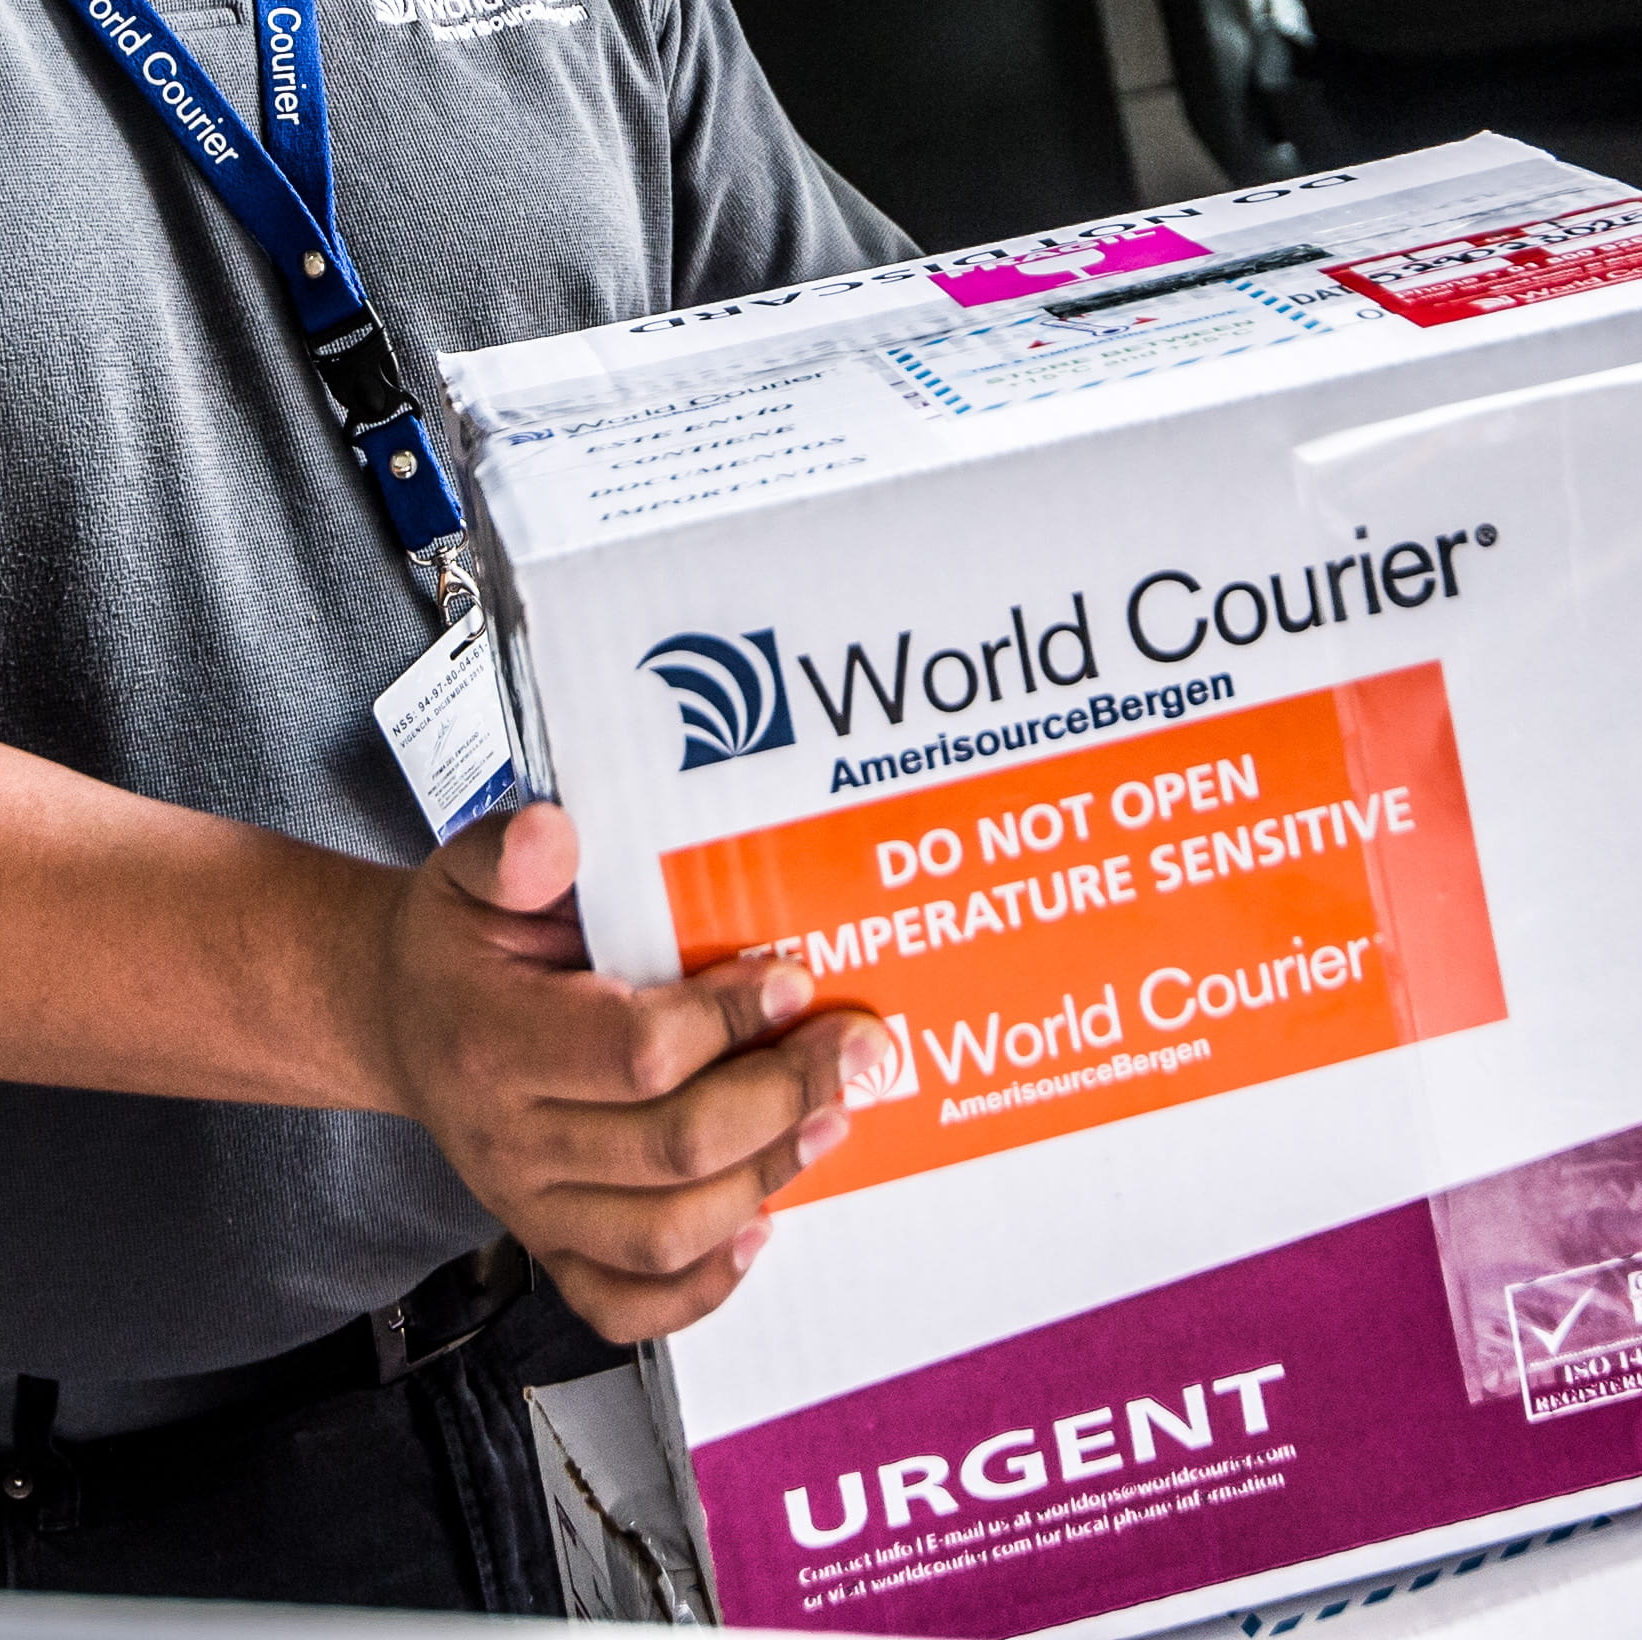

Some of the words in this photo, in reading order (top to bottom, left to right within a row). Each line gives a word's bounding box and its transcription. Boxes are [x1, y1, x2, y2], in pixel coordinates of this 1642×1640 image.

[267, 8, 307, 125] Courier
[142, 51, 239, 164] Courier
[1234, 173, 1357, 205] DO
[1031, 208, 1203, 252] NOT
[629, 248, 1009, 334] DISCARD
[1288, 285, 1354, 305] DAT
[1515, 275, 1602, 298] World
[986, 356, 1082, 385] STORE
[1100, 319, 1255, 359] BETWEEN
[562, 402, 676, 434] World
[689, 371, 825, 407] Courier
[586, 430, 672, 454] ESTE
[588, 435, 847, 499] DOCUMENTOS
[611, 423, 795, 470] CONTIENE
[600, 456, 868, 521] IMPORTANTES
[433, 678, 469, 715] DICIEMBRE
[797, 593, 1100, 737] World
[392, 710, 418, 737] NSS:
[828, 670, 1236, 794] AmerisourceBergen
[875, 826, 962, 889] DO
[977, 794, 1094, 859] NOT
[1111, 753, 1261, 831] OPEN
[1152, 786, 1416, 893] SENSITIVE
[922, 982, 1123, 1086] World
[1139, 933, 1370, 1020] Courier
[937, 1034, 1212, 1126] AmerisourceBergen
[1563, 1353, 1611, 1385] ISO
[784, 1362, 1285, 1549] URGENT
[798, 1553, 873, 1587] Contact
[875, 1541, 914, 1568] Info
[925, 1520, 985, 1552] E-mail
[987, 1520, 1008, 1537] us
[1013, 1510, 1033, 1531] at
[1036, 1443, 1297, 1525] worldops@worldcourier.com
[803, 1594, 823, 1611] or
[827, 1579, 867, 1606] visit
[1035, 1529, 1061, 1550] for
[1064, 1514, 1109, 1542] local
[1111, 1502, 1172, 1534] phone
